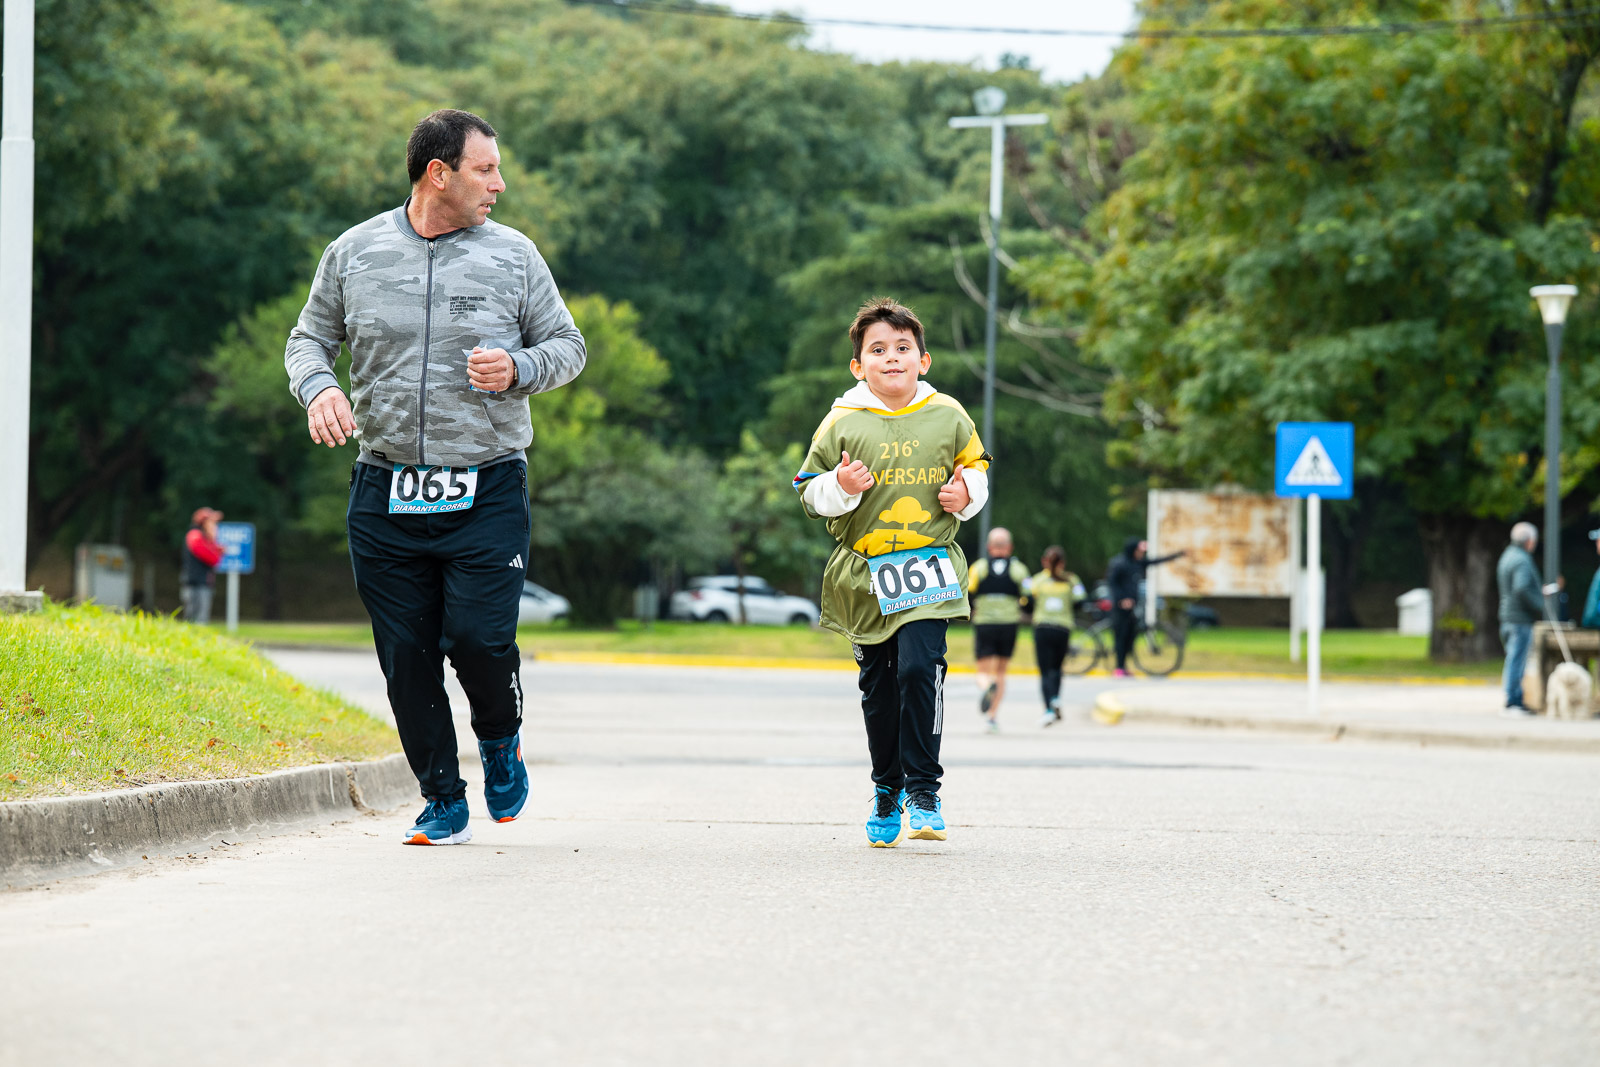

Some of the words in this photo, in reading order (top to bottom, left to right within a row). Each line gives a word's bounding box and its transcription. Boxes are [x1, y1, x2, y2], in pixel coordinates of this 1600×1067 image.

[879, 439, 920, 459] 216°
[396, 465, 469, 503] 065
[869, 466, 947, 486] VERSARIO
[393, 504, 439, 512] DIAMANTE
[439, 501, 469, 511] CORRE
[877, 554, 947, 600] 061
[885, 595, 928, 613] DIAMANTE
[929, 590, 957, 602] CORRE
